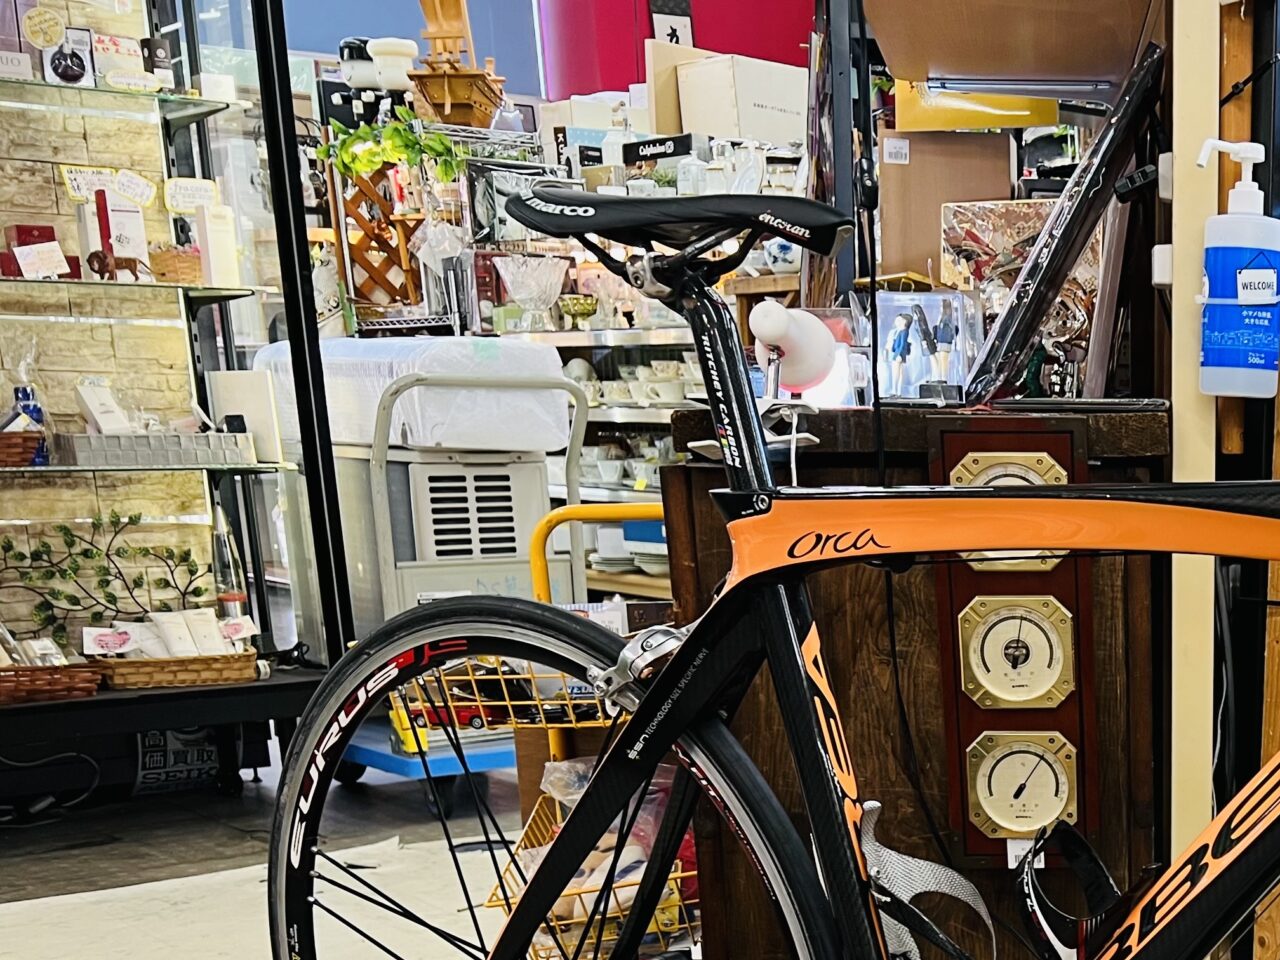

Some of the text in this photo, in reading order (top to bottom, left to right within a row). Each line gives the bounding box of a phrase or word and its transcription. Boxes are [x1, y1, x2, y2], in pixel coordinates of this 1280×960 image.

[525, 198, 597, 218] marco
[1241, 281, 1275, 291] WELCOME
[700, 331, 743, 469] RITCHEY CARBON
[786, 528, 892, 559] Orca
[644, 699, 674, 735] TECHNOLOGY
[141, 767, 219, 785] SEIK
[290, 661, 400, 870] EURUS
